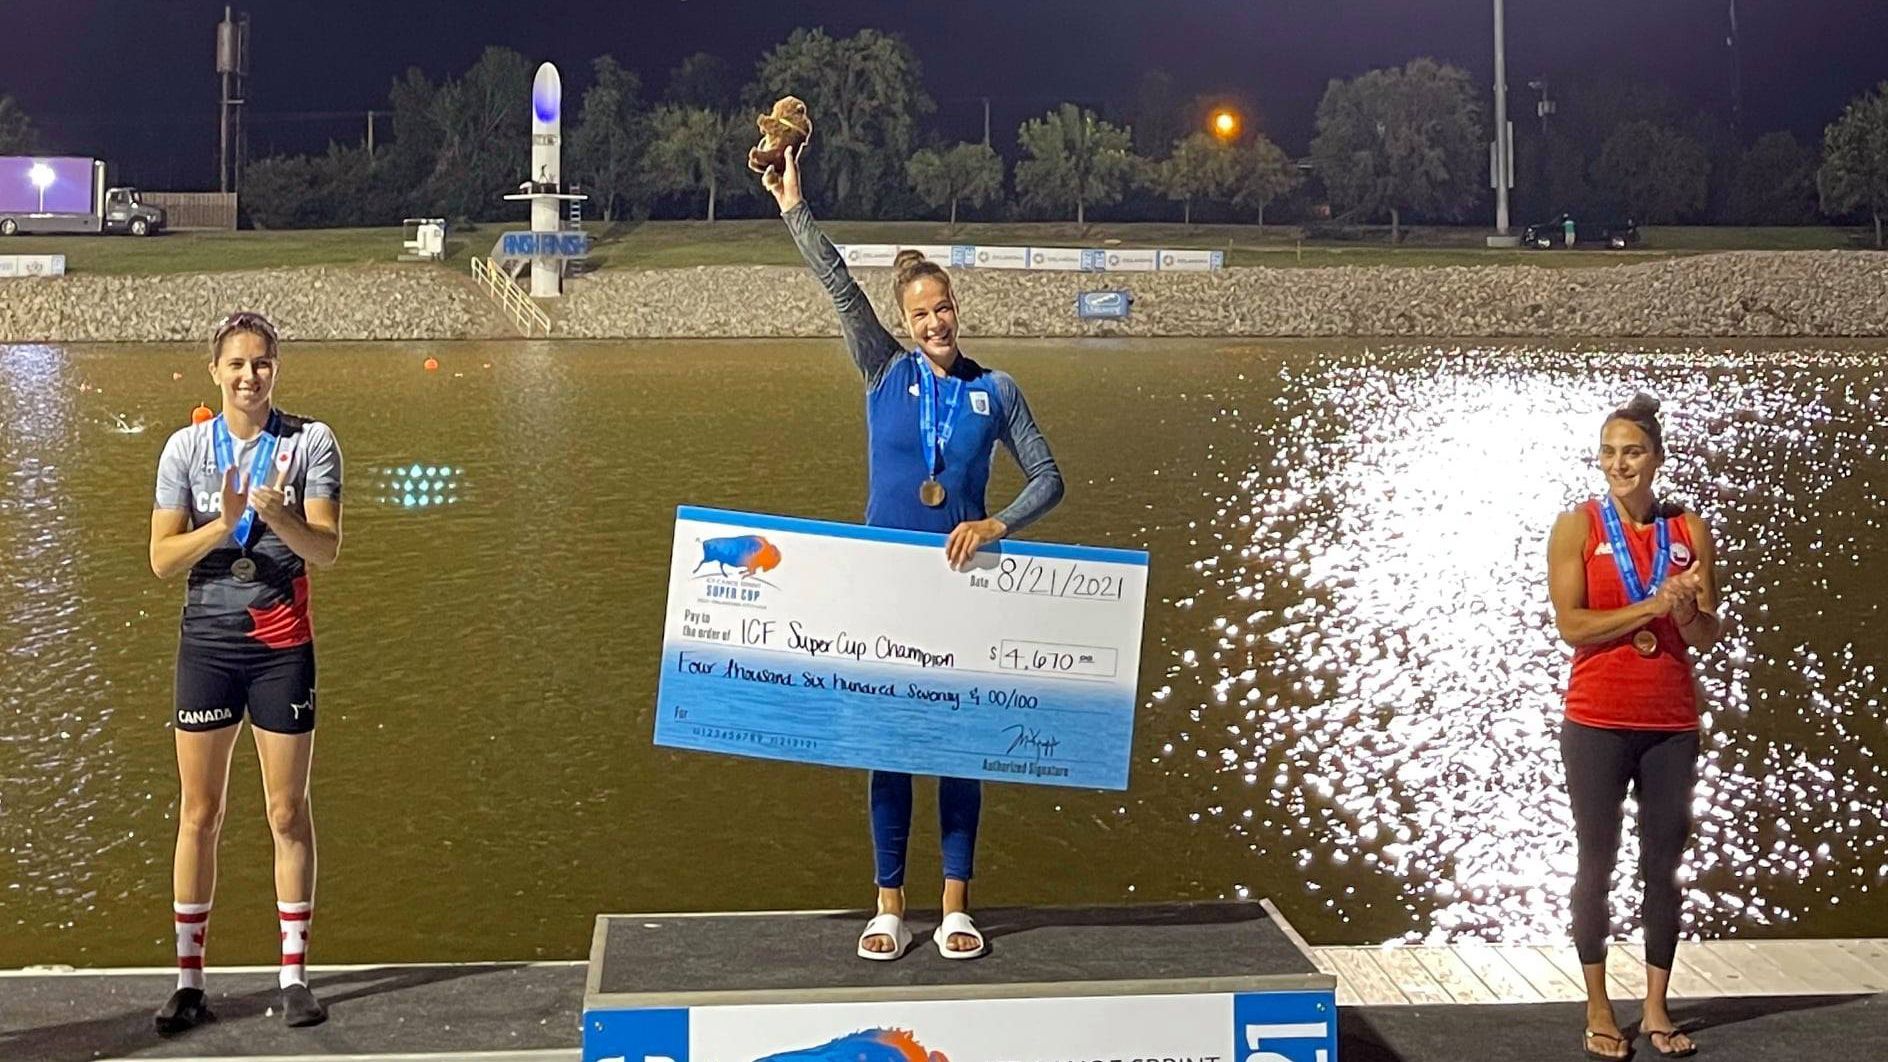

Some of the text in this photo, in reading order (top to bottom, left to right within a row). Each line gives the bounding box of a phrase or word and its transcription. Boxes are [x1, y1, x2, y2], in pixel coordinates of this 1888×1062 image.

[196, 485, 297, 514] CAA
[970, 574, 989, 589] Date
[997, 557, 1124, 599] 8/21/2021
[706, 585, 761, 602] SUPER CUP
[684, 609, 711, 625] Pay to
[683, 625, 731, 642] the order of
[741, 618, 777, 645] ICF
[875, 635, 955, 668] Champion
[989, 645, 998, 661] $
[678, 651, 716, 674] Four
[988, 688, 1038, 710] 00/100
[178, 708, 233, 725] CANADA
[674, 705, 689, 720] For
[983, 758, 1069, 778] Authorized Signature
